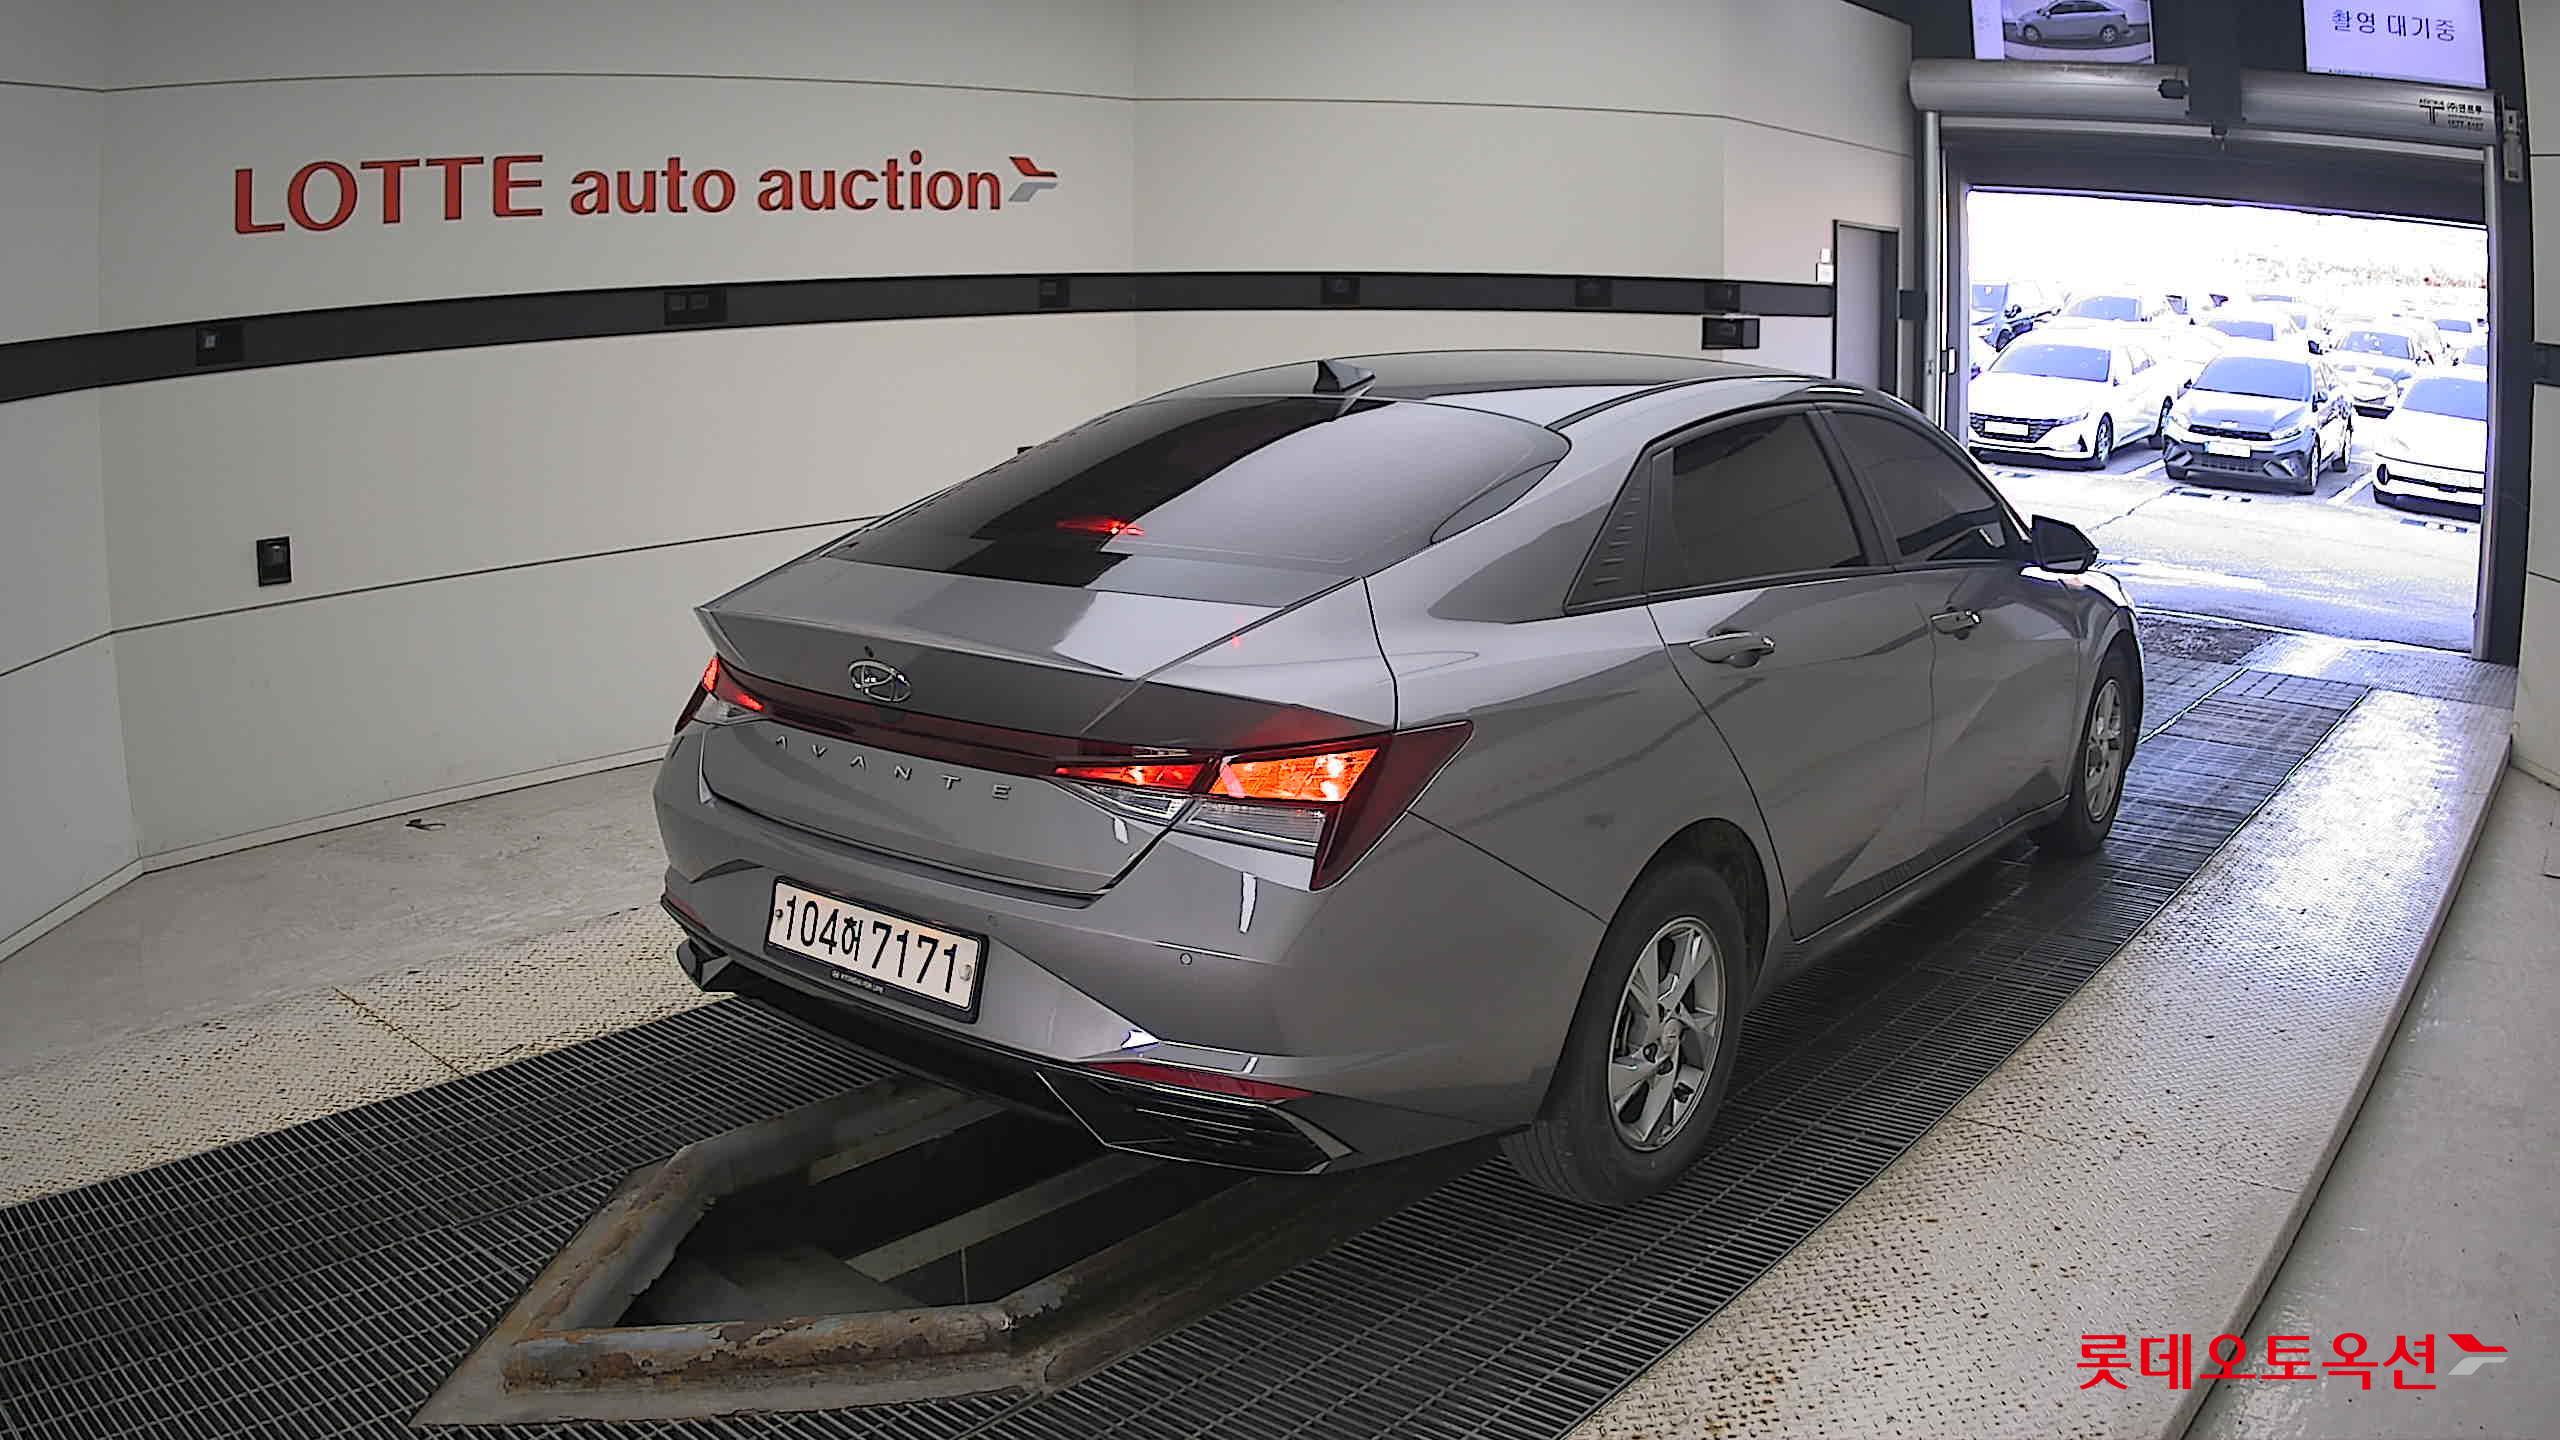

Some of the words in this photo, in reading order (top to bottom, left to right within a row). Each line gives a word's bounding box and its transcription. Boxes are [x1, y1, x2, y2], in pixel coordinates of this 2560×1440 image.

[2332, 9, 2376, 34] 촬영
[2387, 15, 2456, 42] 대기중
[235, 154, 544, 234] LOTTE
[570, 156, 736, 215] auto
[757, 149, 1001, 211] auction
[775, 734, 1011, 800] AVANTE
[786, 895, 863, 962] 104허
[871, 920, 959, 993] 7171
